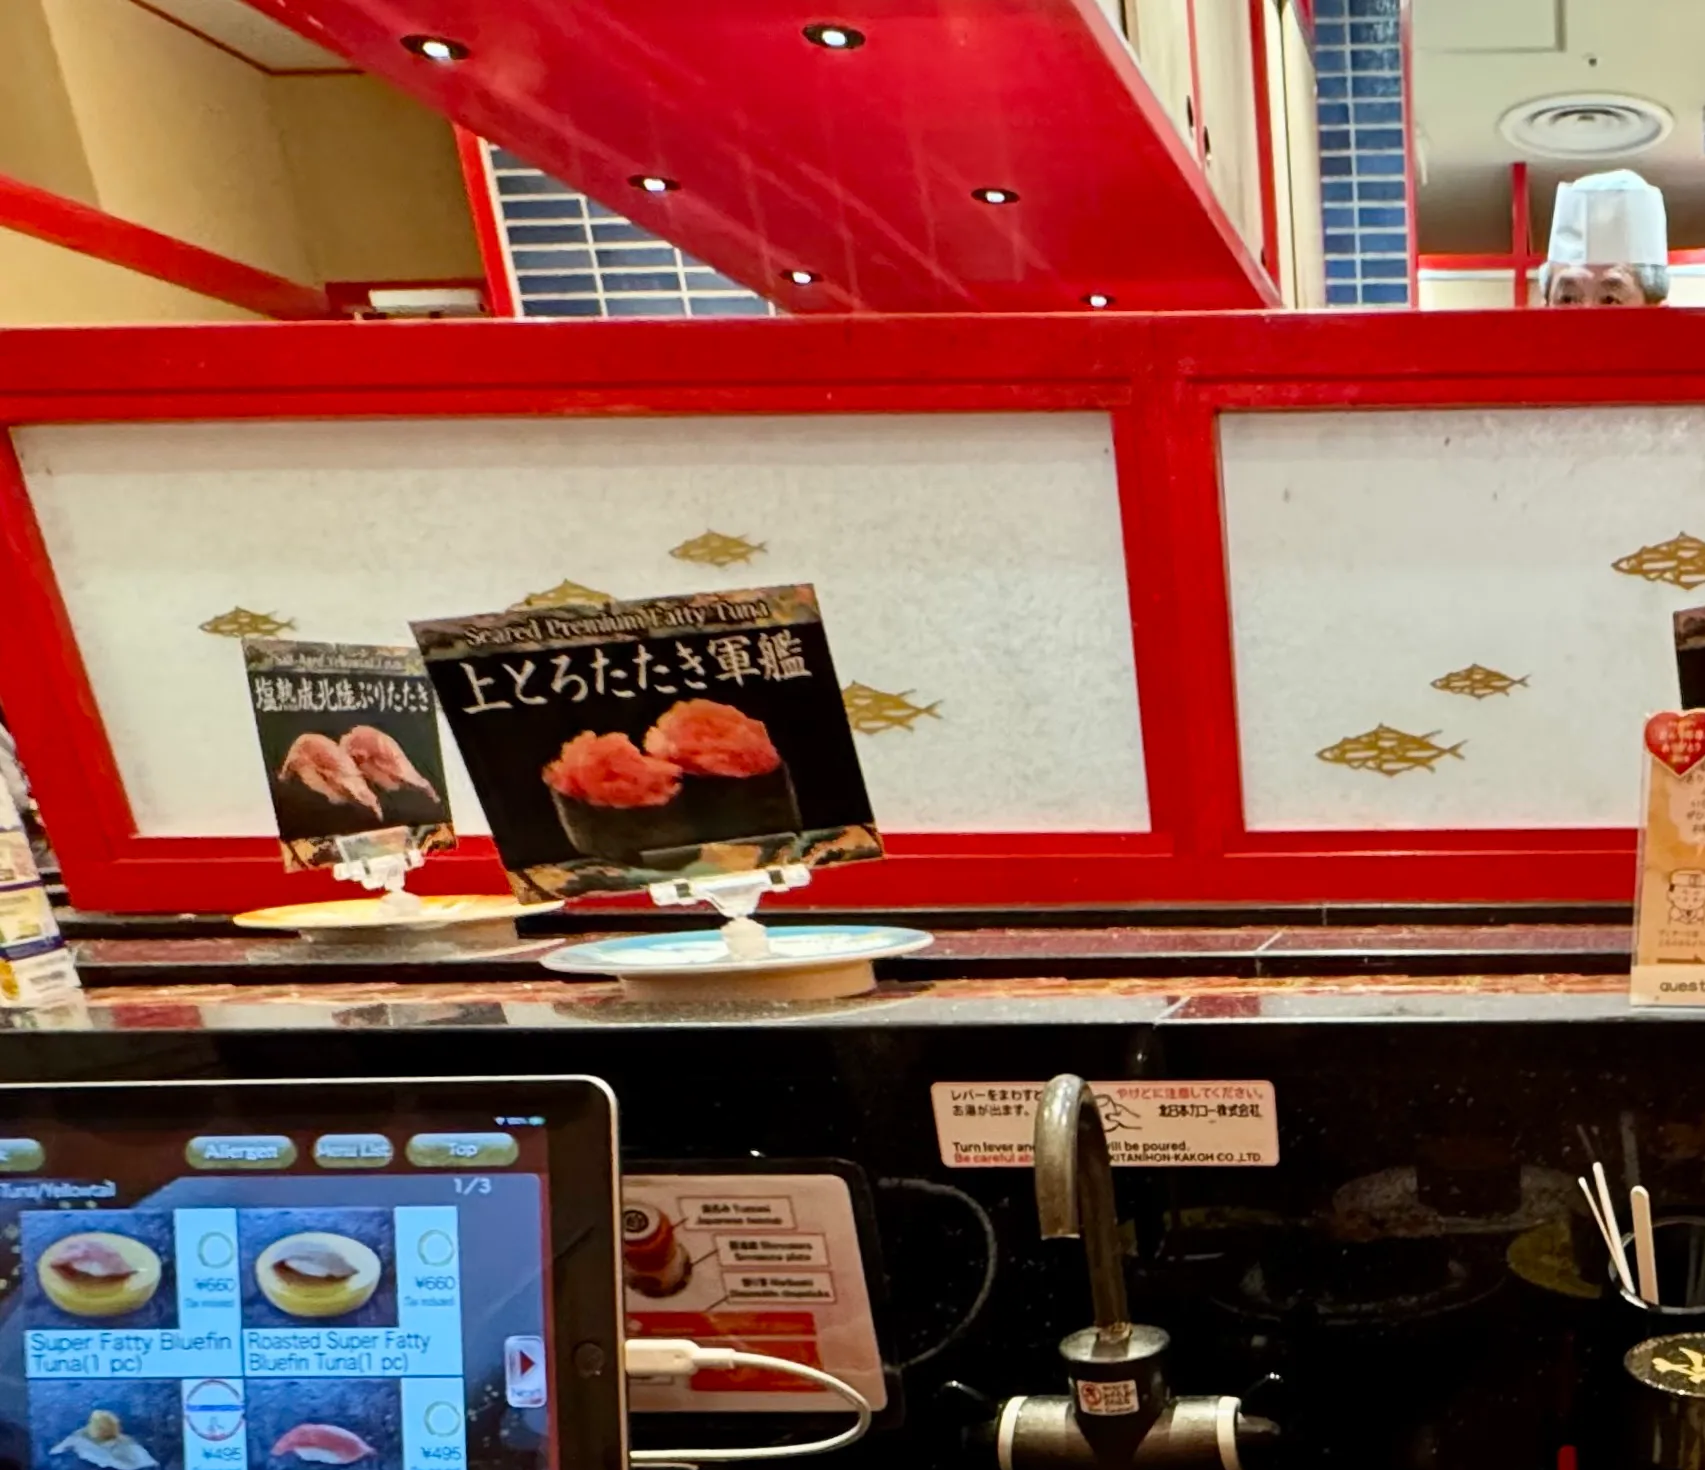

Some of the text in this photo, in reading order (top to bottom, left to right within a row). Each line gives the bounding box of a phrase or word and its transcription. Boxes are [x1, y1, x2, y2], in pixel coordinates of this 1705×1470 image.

[459, 630, 812, 714] 上とろたたき軍艦
[450, 1143, 479, 1158] Top
[953, 1142, 981, 1152] Turn
[983, 1142, 1014, 1152] lever
[1125, 1142, 1139, 1151] be
[453, 1177, 492, 1195] 1/3
[30, 1331, 232, 1355] Super Fatty Bluefin
[248, 1330, 431, 1354] Roasted Super Fatty
[110, 1355, 142, 1375] pc)
[249, 1353, 309, 1371] Bluefin
[381, 1353, 409, 1374] pc)
